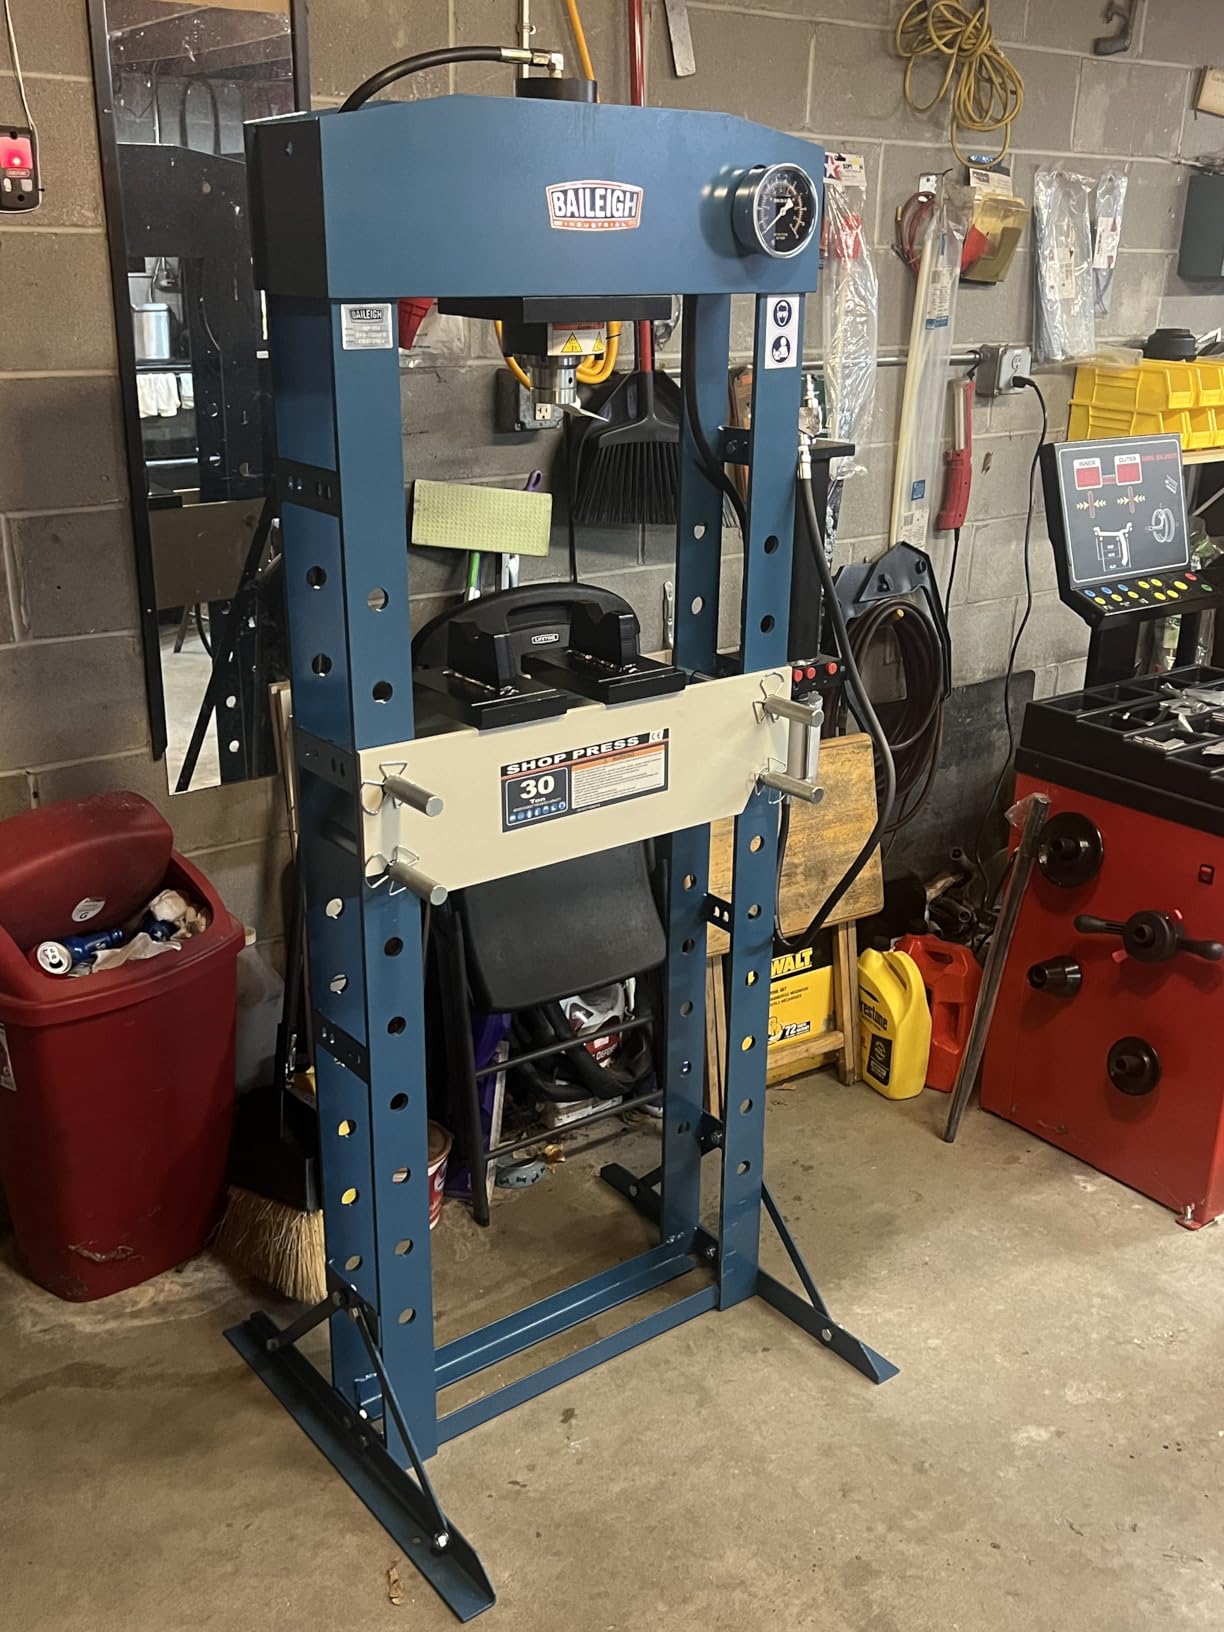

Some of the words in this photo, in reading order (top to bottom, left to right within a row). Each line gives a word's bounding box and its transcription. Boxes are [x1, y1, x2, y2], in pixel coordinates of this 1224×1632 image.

[552, 187, 638, 218] BAILEIGH
[564, 220, 626, 229] INDUSTRIAL
[351, 308, 383, 320] BAILEIGH
[506, 751, 567, 775] SHOP
[572, 736, 640, 760] PRESS
[519, 775, 555, 799] 30
[771, 949, 813, 977] WALT
[785, 1023, 797, 1036] 72
[860, 1002, 888, 1031] restone
